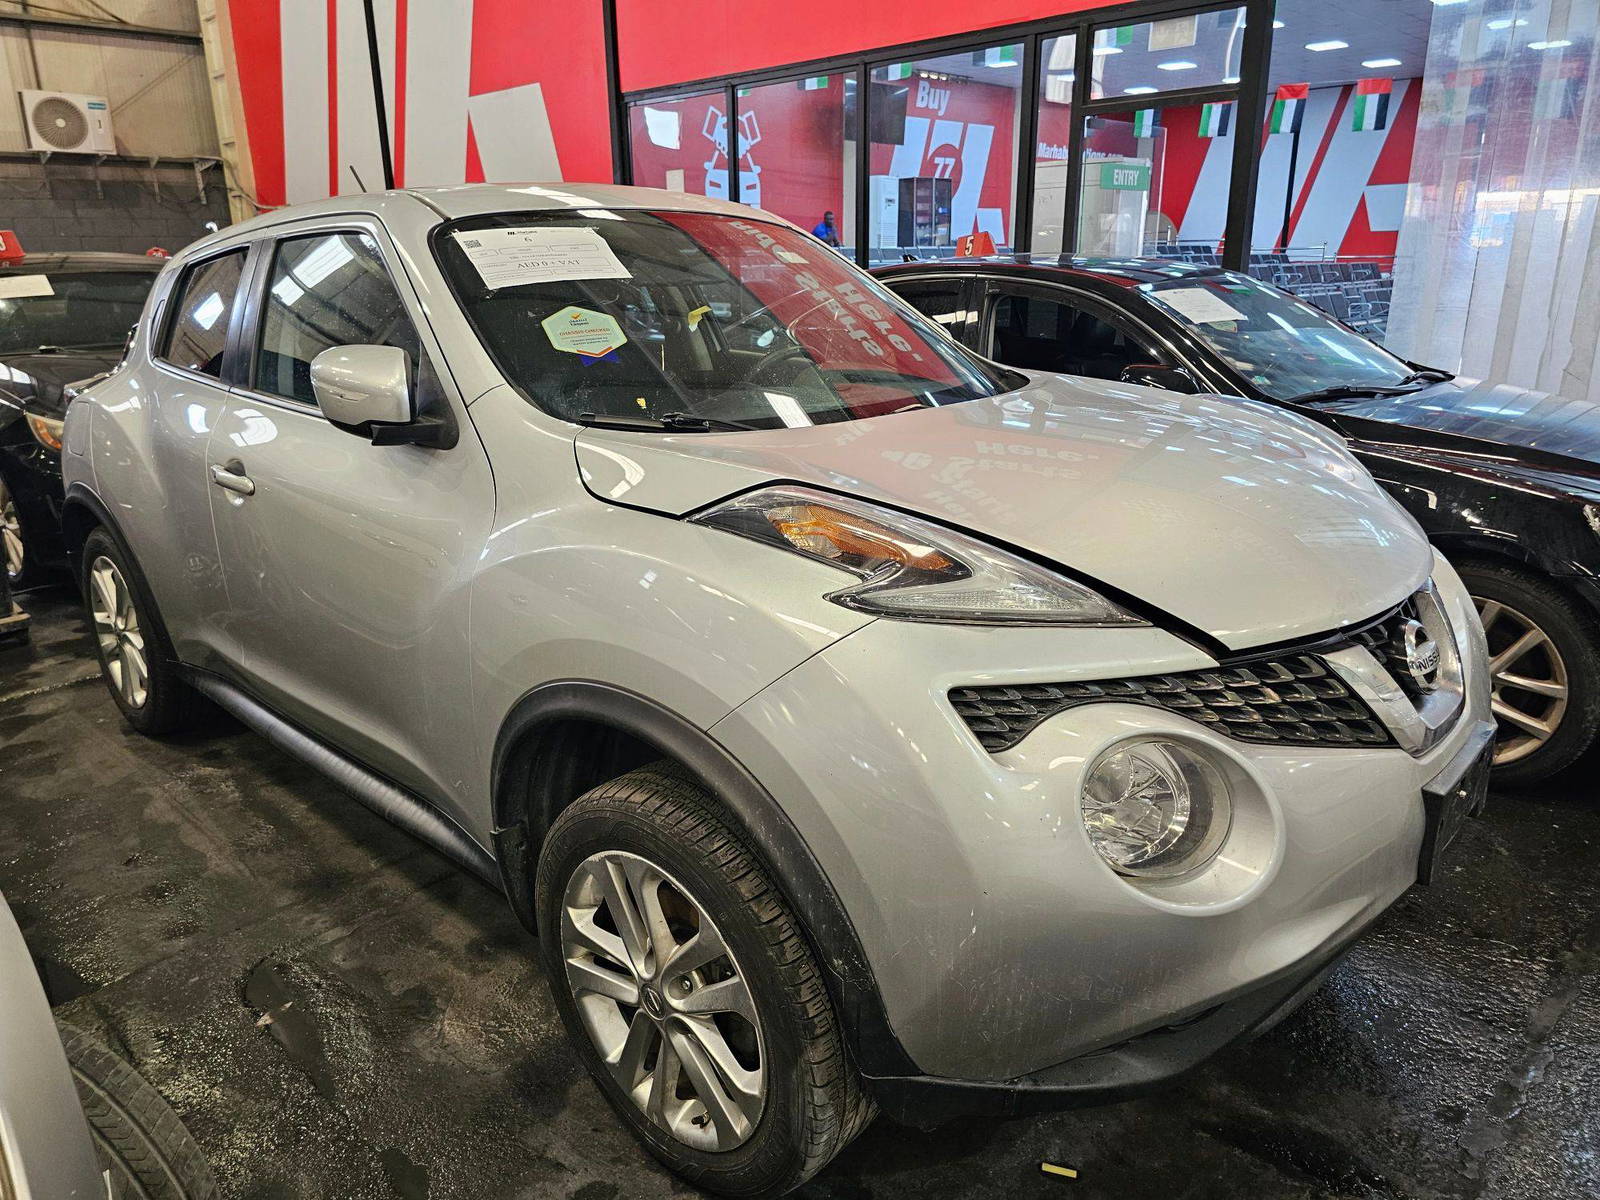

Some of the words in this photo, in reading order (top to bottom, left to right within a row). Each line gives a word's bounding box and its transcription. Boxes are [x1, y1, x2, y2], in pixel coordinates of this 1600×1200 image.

[916, 80, 951, 116] Buy
[934, 157, 956, 179] 77
[1113, 169, 1140, 186] ENTRY
[965, 235, 975, 257] 5
[517, 261, 540, 269] AED
[1417, 651, 1440, 671] NISS
